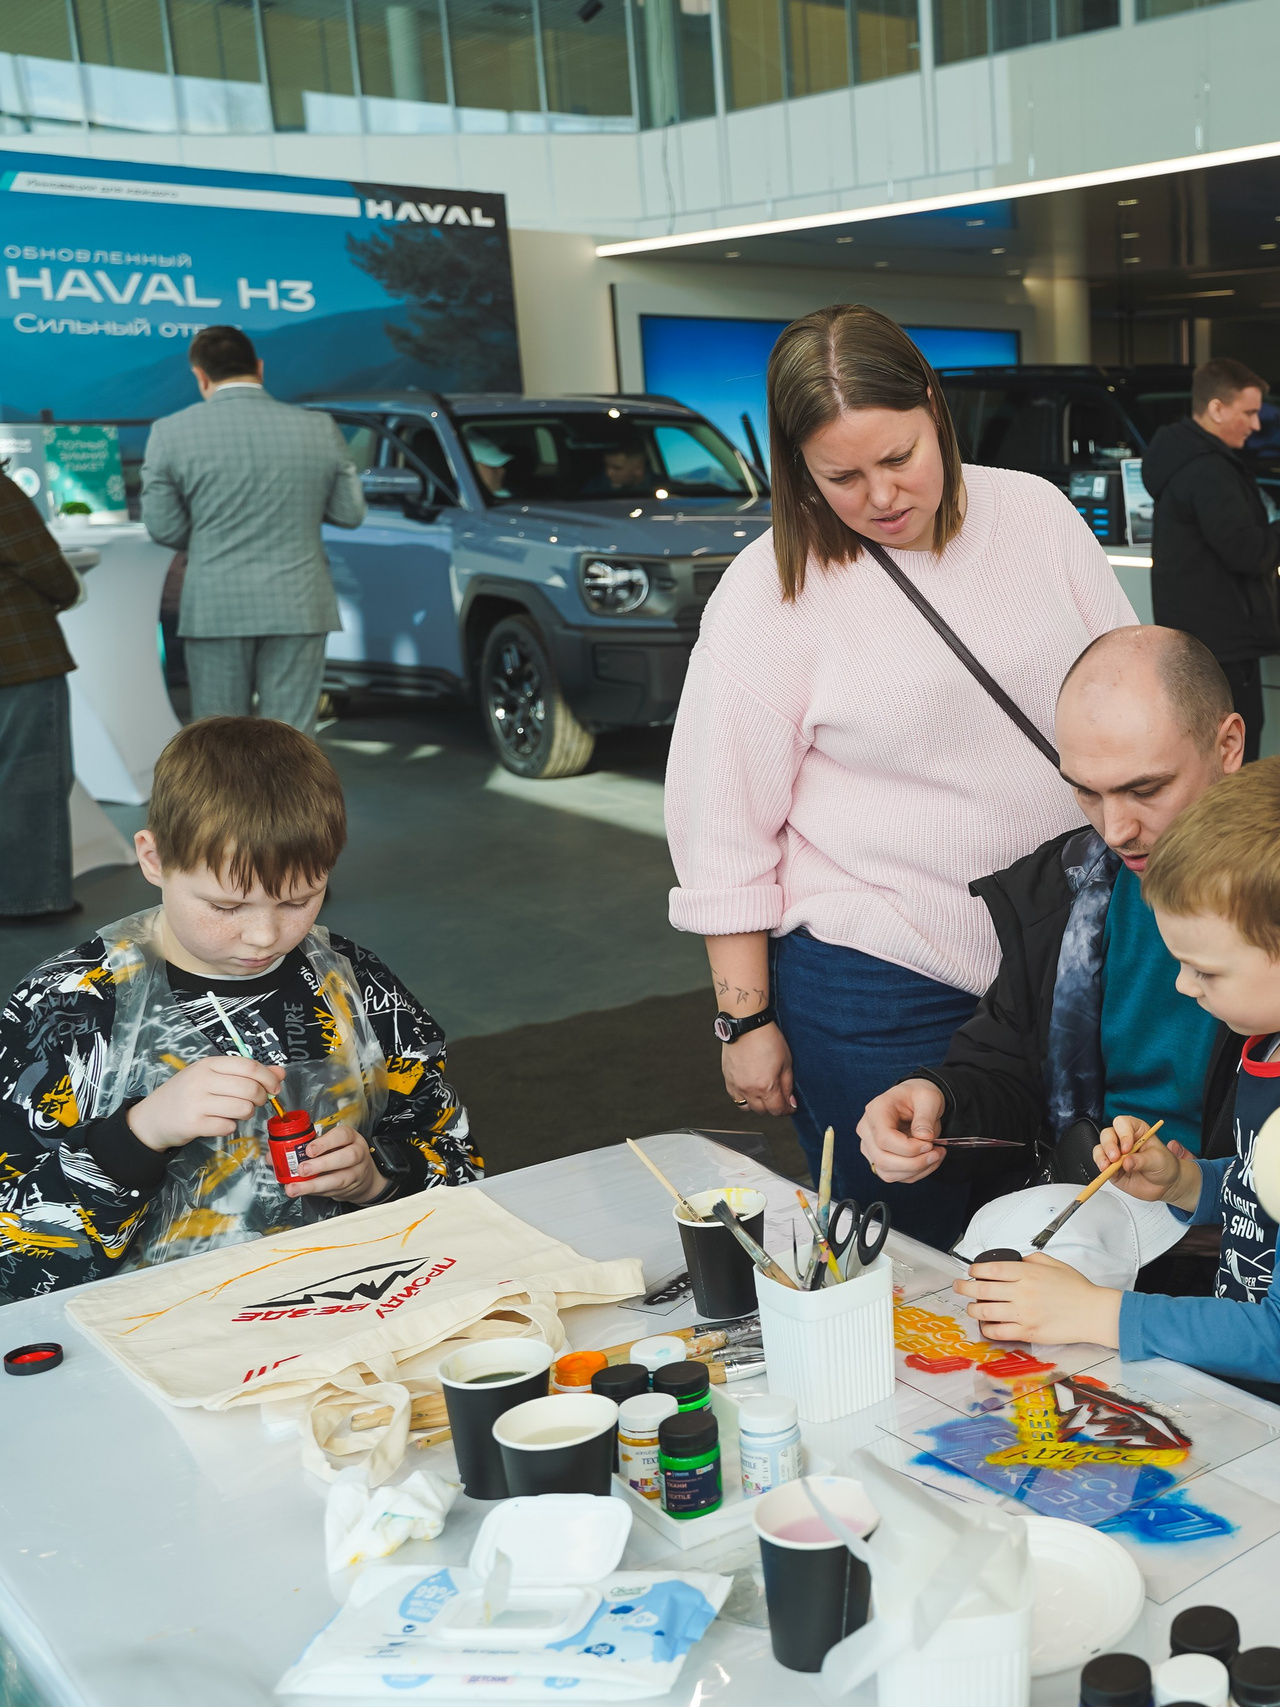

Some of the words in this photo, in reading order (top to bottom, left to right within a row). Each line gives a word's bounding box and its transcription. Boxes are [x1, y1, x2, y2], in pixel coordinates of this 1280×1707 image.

[366, 199, 495, 228] HAVAL
[4, 244, 193, 268] ОБНОВЛЕННЫЙ
[5, 265, 222, 309] HAVAL
[236, 277, 316, 313] H3
[13, 312, 151, 337] Сильный
[283, 1001, 311, 1062] UTURE
[1223, 1186, 1259, 1221] FLIGHT
[1229, 1217, 1265, 1244] SHOW
[375, 1256, 457, 1320] ПРОЙДУ
[231, 1302, 372, 1322] ВЕЗДЕ
[642, 1457, 659, 1466] TEXT
